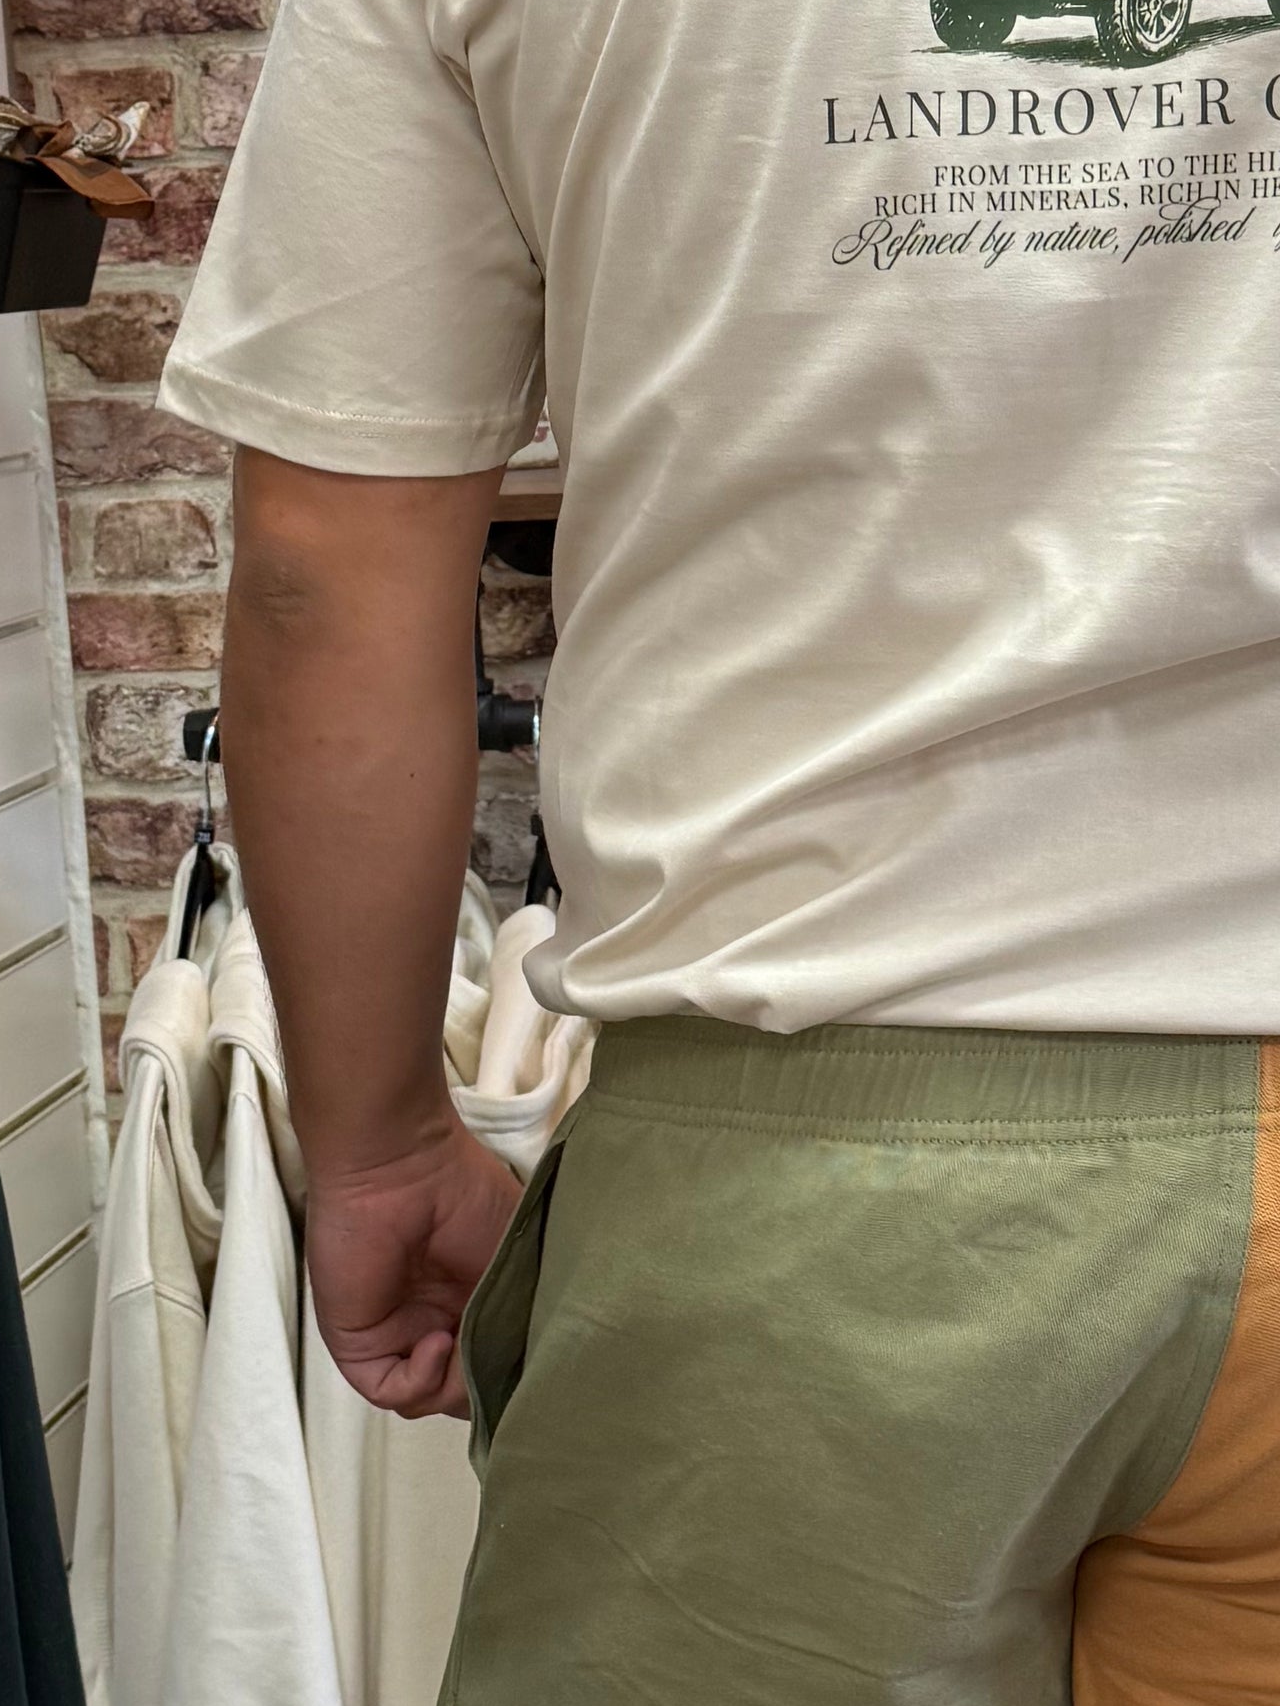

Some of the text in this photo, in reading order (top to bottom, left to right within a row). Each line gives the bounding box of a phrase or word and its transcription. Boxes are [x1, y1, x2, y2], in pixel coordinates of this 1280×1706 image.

[823, 78, 1236, 144] LANDROVER
[934, 164, 1010, 188] FROM
[1018, 163, 1072, 185] THE
[1081, 161, 1131, 184] SEA
[1138, 157, 1175, 179] TO
[1184, 153, 1238, 177] THE
[874, 193, 937, 217] RICH
[948, 191, 975, 213] IN
[985, 187, 1129, 212] MINERALS,
[1139, 181, 1203, 206] RICH
[1212, 179, 1241, 201] IN
[831, 216, 982, 270] Refined
[979, 220, 1017, 269] by
[1122, 196, 1257, 264] polished
